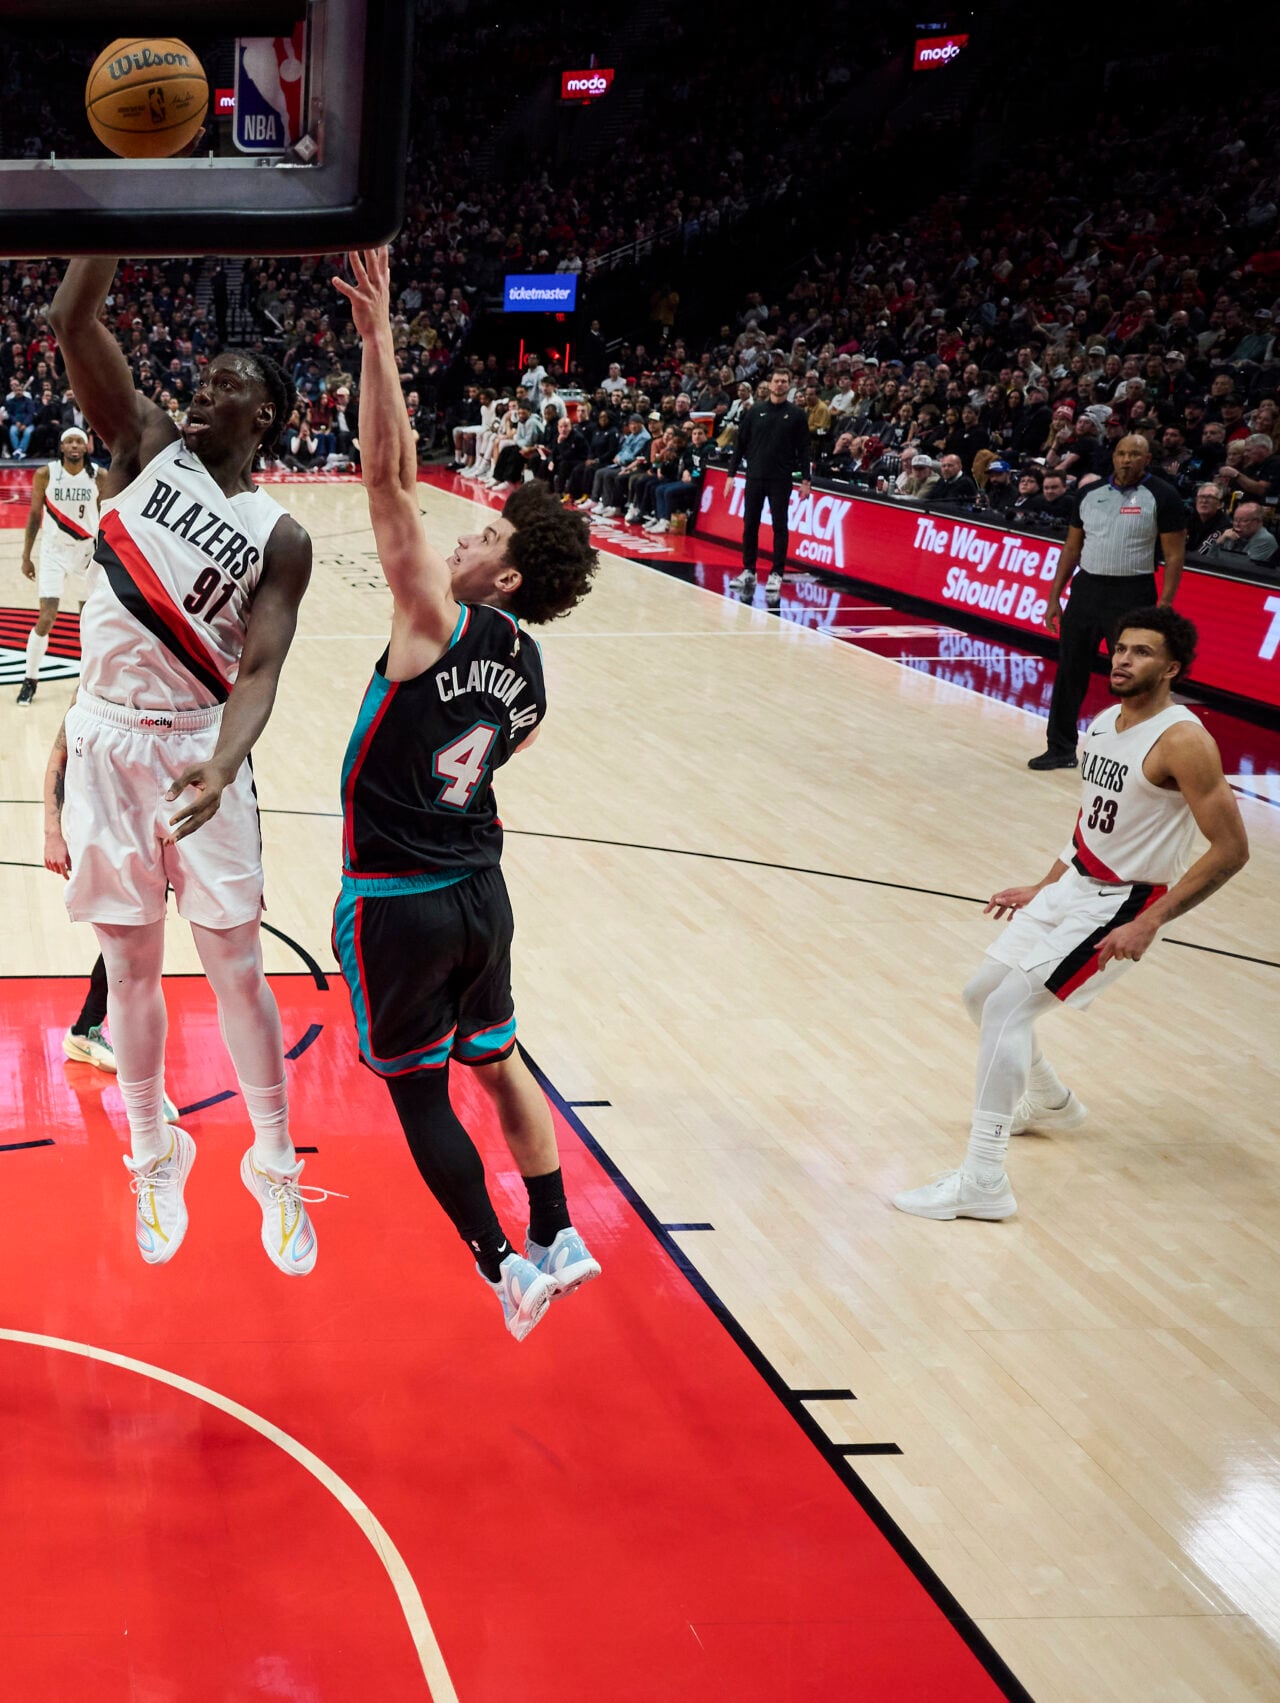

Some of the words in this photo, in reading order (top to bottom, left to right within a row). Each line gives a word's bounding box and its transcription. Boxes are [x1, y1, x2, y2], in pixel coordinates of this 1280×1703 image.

[107, 48, 190, 80] Wilson
[567, 77, 607, 91] moda
[244, 114, 276, 141] NBA
[509, 286, 571, 300] ticketmaster
[54, 487, 92, 501] BLAZERS
[78, 504, 85, 519] 9
[140, 479, 260, 581] BLAZERS
[795, 539, 833, 565] .com
[913, 517, 949, 554] The
[950, 525, 999, 573] Way
[998, 536, 1040, 577] Tire
[183, 567, 238, 624] 91
[942, 566, 1019, 616] Should
[435, 659, 528, 707] CLAYTON
[509, 703, 538, 740] JR.
[140, 716, 173, 729] ripcity
[431, 719, 502, 814] 4
[1087, 795, 1119, 834] 33
